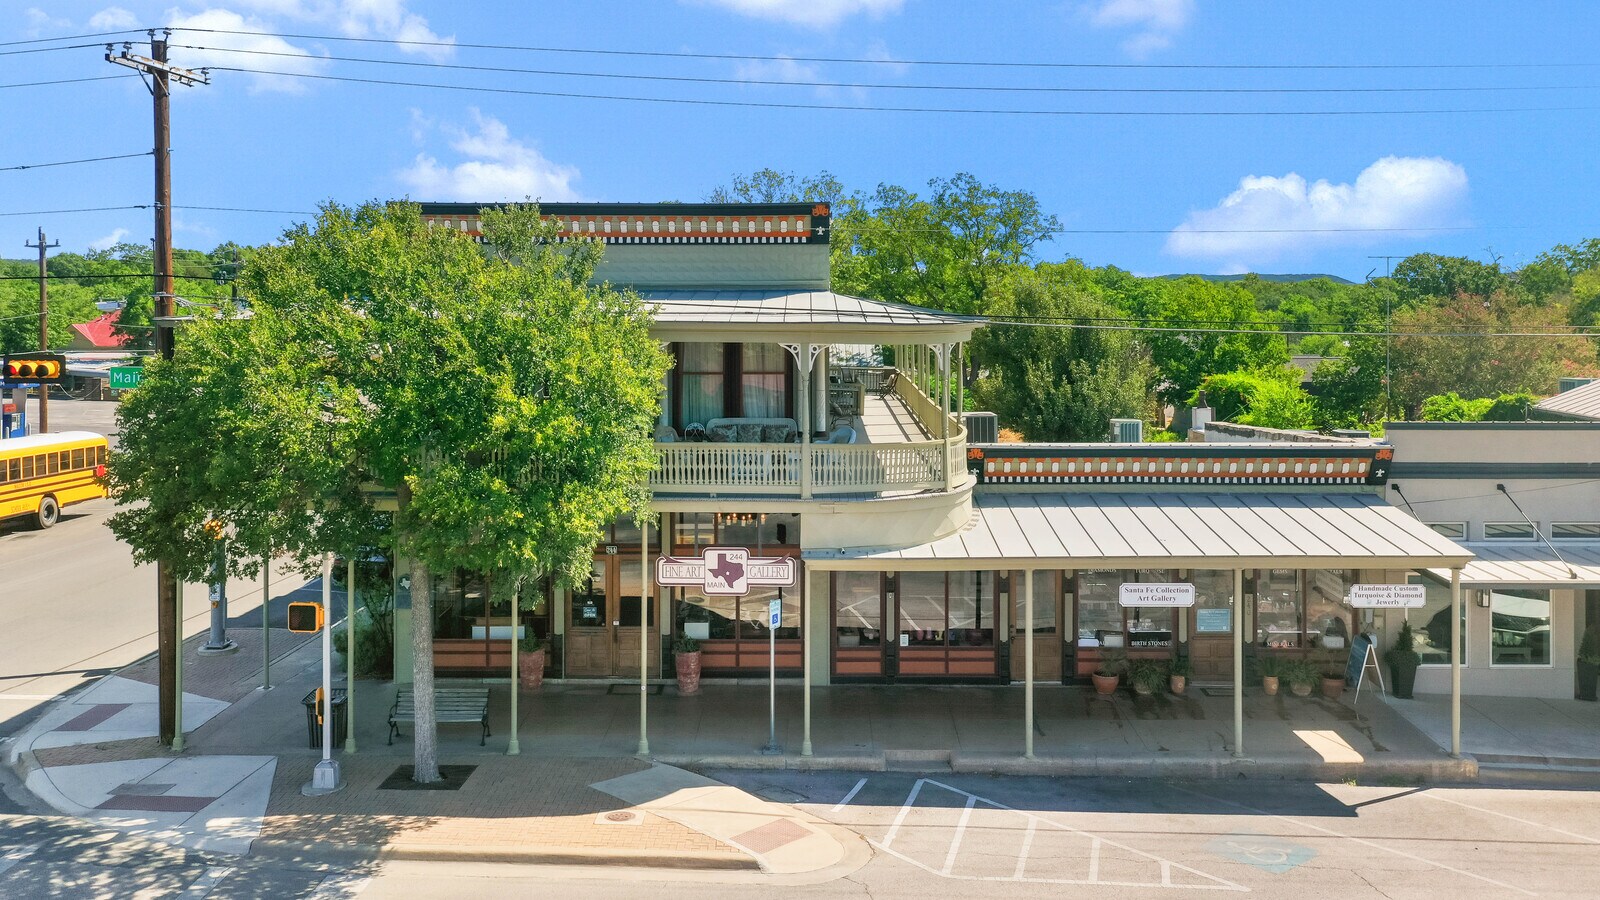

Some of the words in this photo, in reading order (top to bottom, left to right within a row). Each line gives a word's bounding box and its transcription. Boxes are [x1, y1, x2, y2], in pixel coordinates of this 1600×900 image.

[664, 565, 682, 577] FINE
[685, 565, 704, 577] ART
[749, 566, 788, 578] GALLERY
[1150, 595, 1177, 603] Gallery
